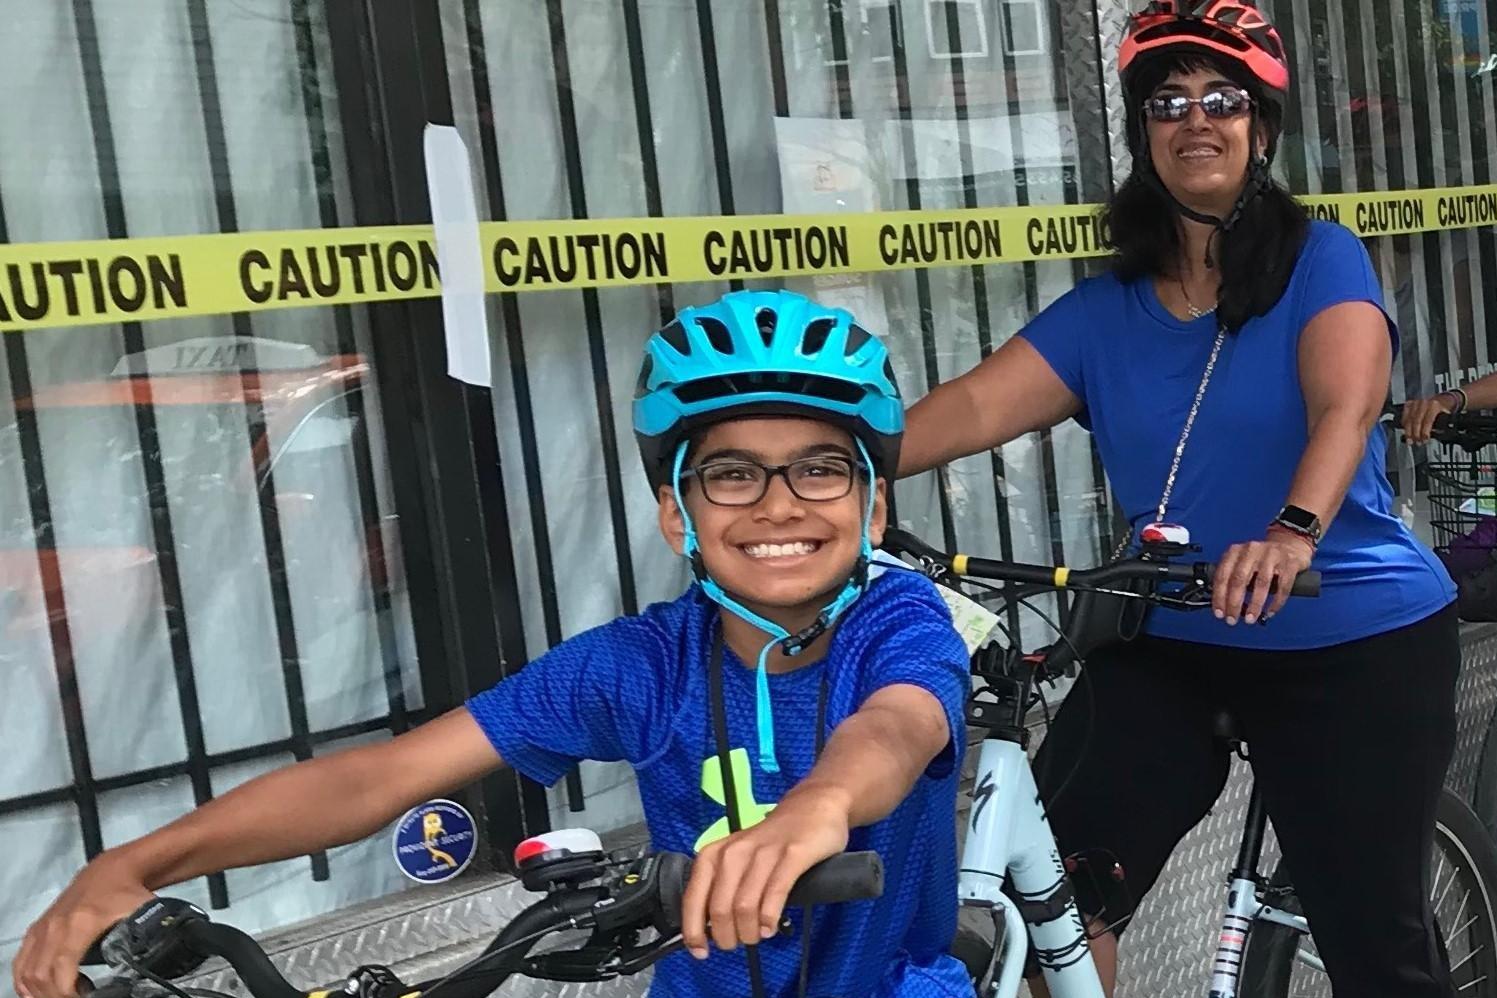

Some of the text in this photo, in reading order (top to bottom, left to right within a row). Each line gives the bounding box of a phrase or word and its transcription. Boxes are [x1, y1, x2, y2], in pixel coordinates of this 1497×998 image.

[239, 240, 442, 303] CAUTION
[493, 232, 668, 287] CAUTION
[703, 226, 850, 275] CAUTION
[879, 219, 1002, 266] CAUTION
[1027, 215, 1117, 256] CAUTIO
[1356, 199, 1424, 233] CAUTION
[1438, 193, 1497, 226] CAUTION
